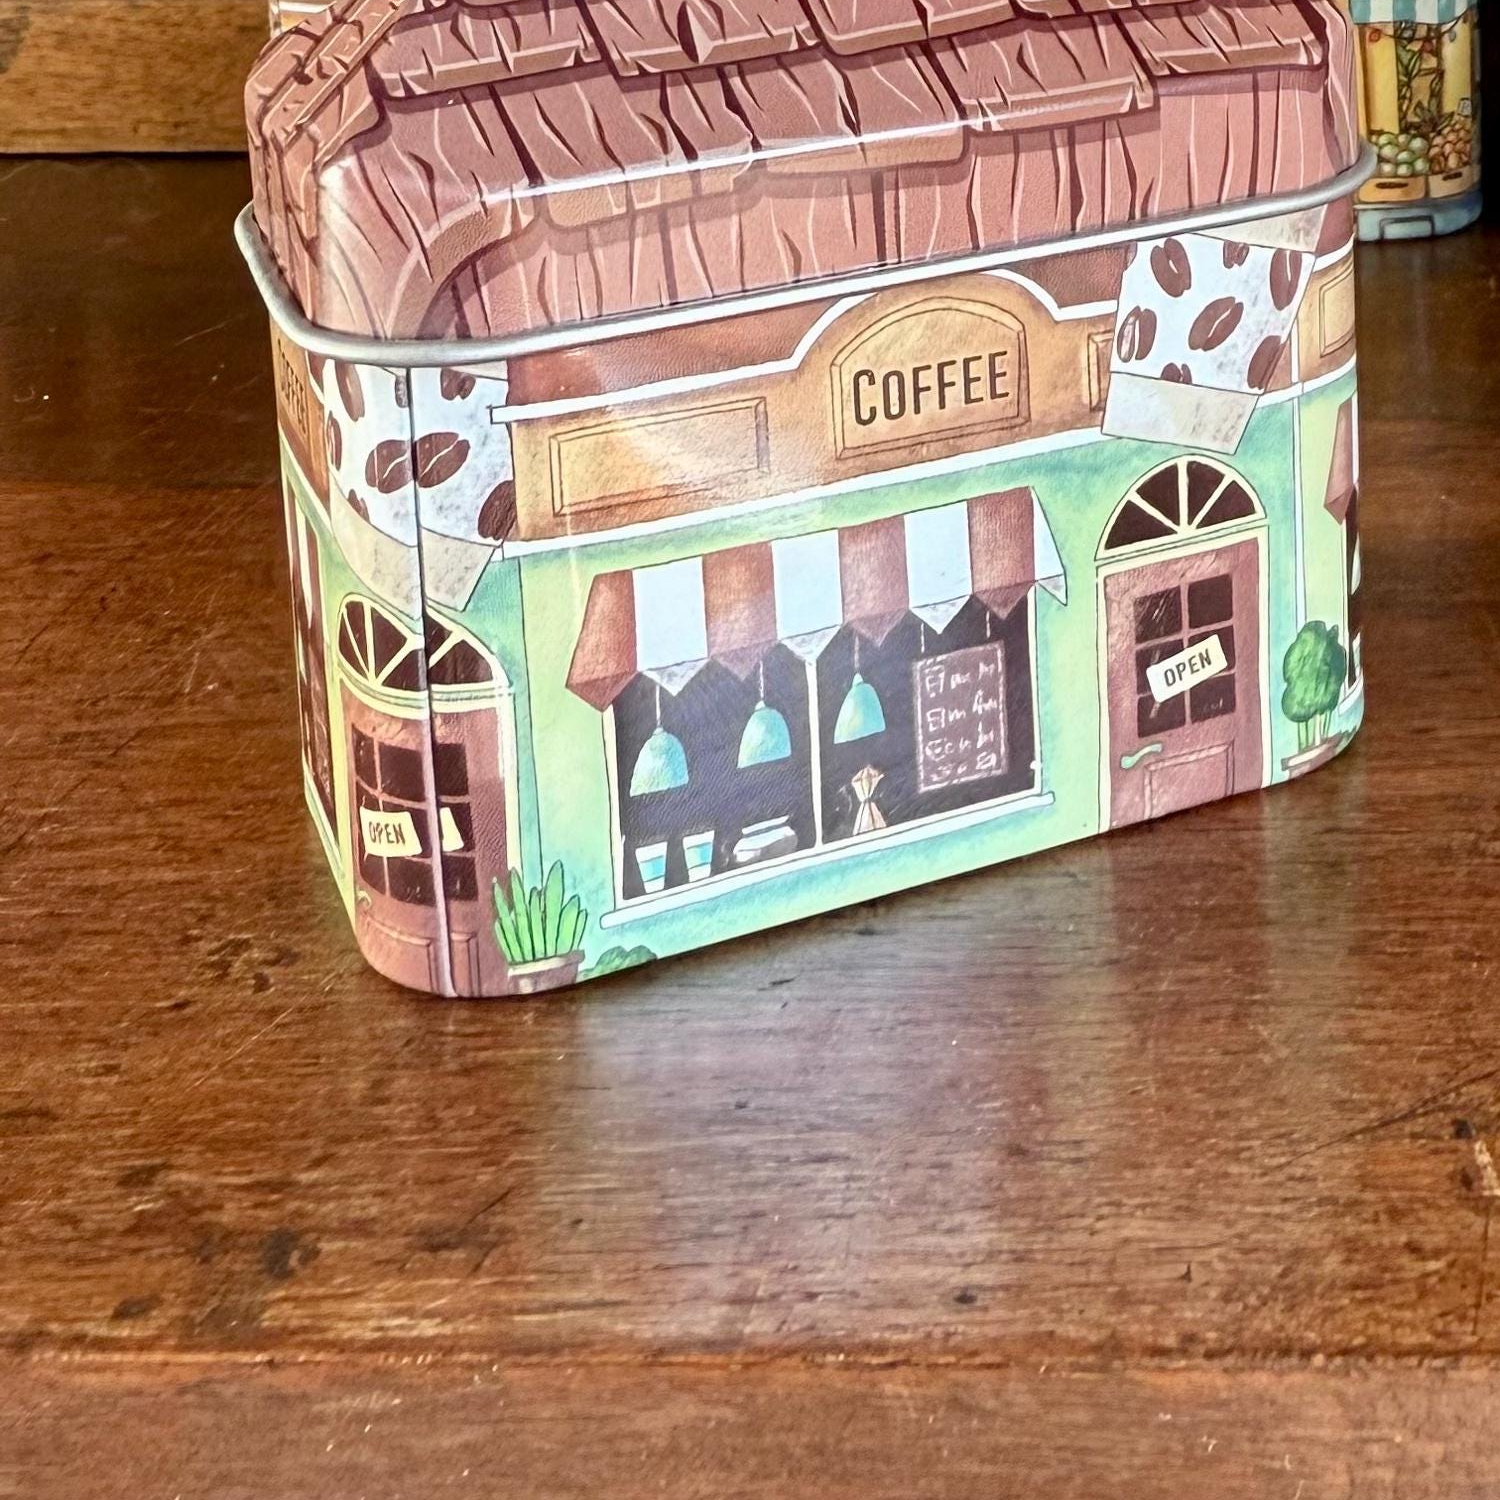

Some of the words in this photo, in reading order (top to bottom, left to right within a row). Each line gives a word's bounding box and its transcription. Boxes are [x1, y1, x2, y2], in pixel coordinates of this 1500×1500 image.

[853, 350, 1010, 427] COFFEE
[1163, 647, 1213, 688] OPEN
[368, 820, 406, 845] OPEN
